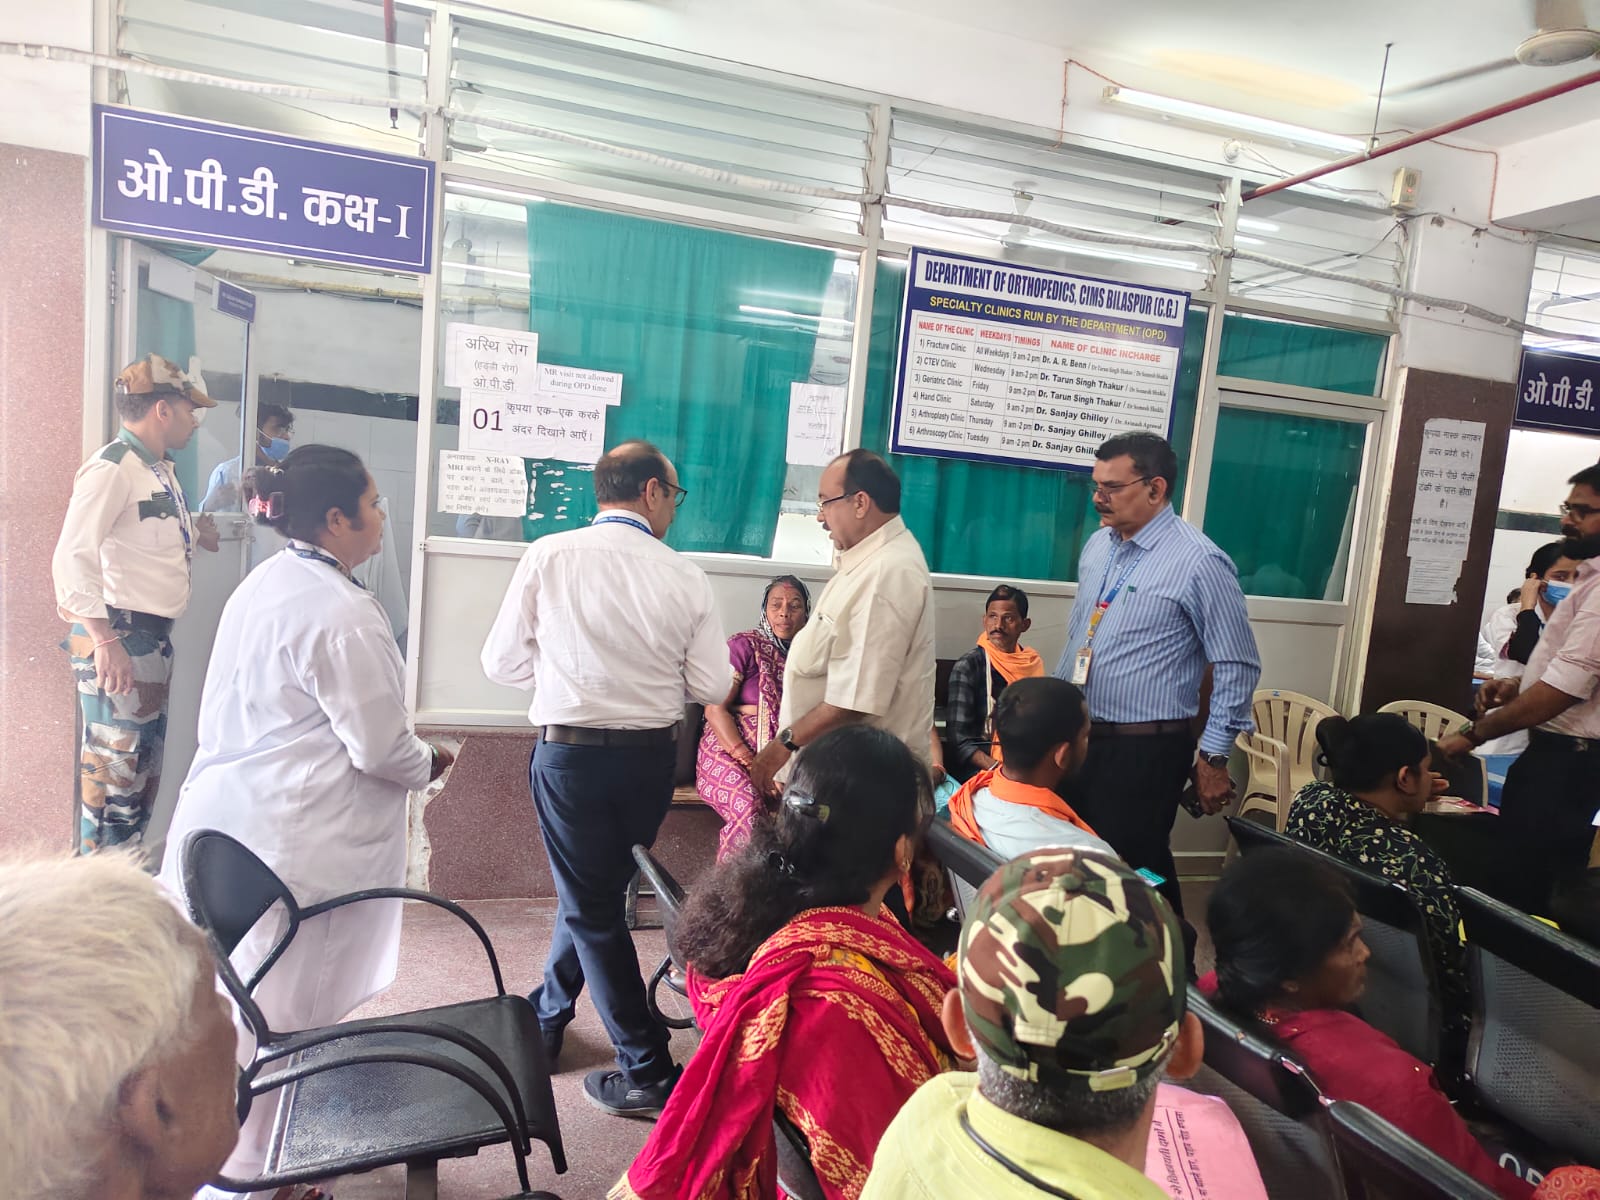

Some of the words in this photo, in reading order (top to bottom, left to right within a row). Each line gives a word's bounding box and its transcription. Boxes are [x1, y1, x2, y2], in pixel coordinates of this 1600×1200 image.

[118, 148, 288, 221] ओ.पी.डी.
[302, 187, 414, 239] कक्ष-I
[925, 260, 992, 290] DEPARTMENT
[993, 271, 1007, 292] OF
[1008, 273, 1077, 305] ORTHOPEDICS,
[1079, 284, 1105, 308] CIMS
[1106, 289, 1152, 315] BILASPUR
[1153, 296, 1179, 319] (C.G.)
[930, 296, 982, 313] SPECIALTY
[984, 304, 1021, 319] CLINICS
[1023, 309, 1043, 322] RUN
[1045, 312, 1059, 324] BY
[1061, 315, 1078, 327] THE
[1080, 319, 1141, 337] DEPARTMENT
[1142, 327, 1167, 342] (OPD)
[465, 336, 501, 352] अस्थि
[506, 340, 528, 356] रोग
[919, 321, 934, 331] NAME
[935, 323, 943, 331] OF
[944, 324, 955, 334] THE
[956, 326, 975, 336] CLINIC
[1014, 335, 1041, 346] TIMINGS
[1050, 340, 1075, 351] NAME
[1076, 343, 1088, 352] OF
[1090, 345, 1117, 357] CLINIC
[1119, 349, 1161, 363] INCHARGE
[926, 339, 950, 350] Fracture
[950, 342, 967, 353] Clinic
[984, 346, 1010, 359] Weekdays
[1042, 355, 1051, 364] Dr.
[1052, 358, 1060, 366] A.
[1061, 358, 1068, 367] R.
[1070, 359, 1087, 369] Benn
[502, 362, 518, 376] रोग)
[588, 374, 614, 382] allowed
[916, 356, 922, 365] 2)
[923, 356, 939, 366] CTEV
[940, 358, 957, 369] Clinic
[974, 363, 1005, 376] Wednesday
[1040, 372, 1050, 381] Dr.
[1052, 374, 1073, 384] Tarun
[1075, 377, 1096, 388] Singh
[1098, 380, 1124, 392] Thakur
[551, 379, 572, 389] during
[915, 373, 920, 383] 3)
[922, 374, 946, 386] Geriatric
[946, 377, 963, 387] Clinic
[972, 380, 989, 392] Friday
[1038, 389, 1048, 398] Dr.
[1050, 391, 1072, 401] Tarun
[1073, 394, 1094, 405] Singh
[1096, 397, 1121, 408] Thakur
[1523, 372, 1595, 411] ओ.पी.डी.
[473, 408, 503, 431] 01
[507, 402, 531, 415] कृपया
[578, 409, 600, 420] करके
[912, 391, 919, 401] 4)
[920, 392, 935, 401] Hand
[936, 393, 952, 403] Clinic
[970, 397, 995, 410] Saturday
[1036, 406, 1047, 415] Dr.
[1050, 408, 1078, 420] Sanjay
[512, 424, 532, 435] अंदर
[537, 425, 565, 437] दिखाने
[918, 409, 949, 423] Arthroplasty
[950, 413, 965, 422] Clinic
[969, 415, 994, 427] Thursday
[1034, 423, 1045, 432] Dr.
[1047, 425, 1076, 437] Sanjay
[916, 427, 947, 440] Arthroscopy
[948, 431, 963, 440] Clinic
[967, 432, 989, 444] Tuesday
[1032, 440, 1043, 449] Dr.
[1045, 441, 1073, 453] Sanjay
[487, 456, 509, 464] X-RAY
